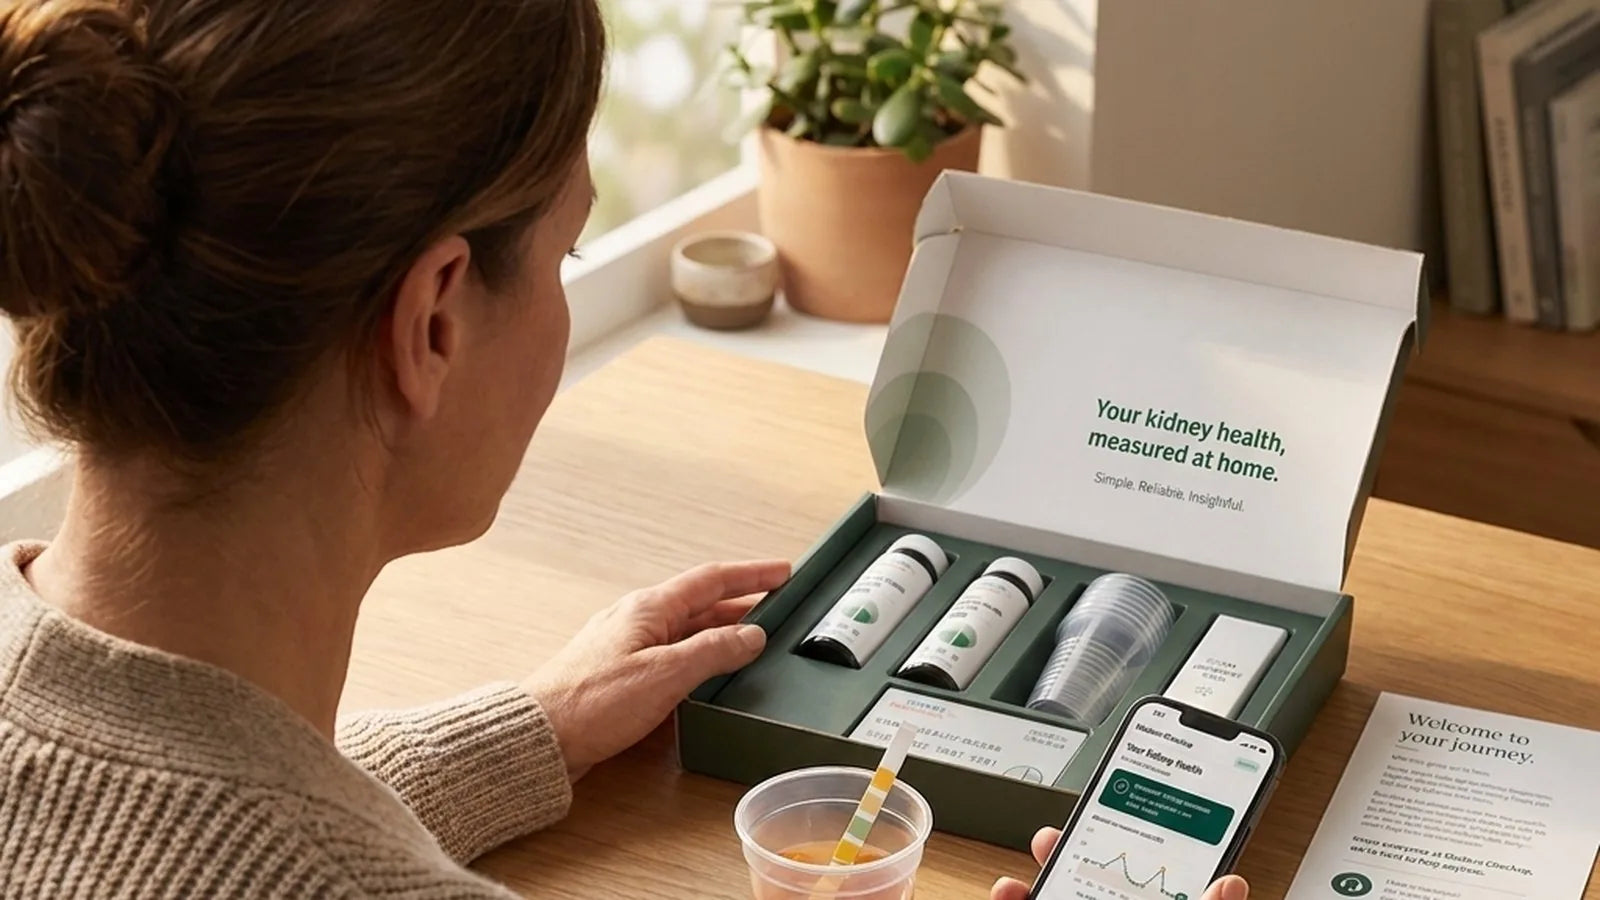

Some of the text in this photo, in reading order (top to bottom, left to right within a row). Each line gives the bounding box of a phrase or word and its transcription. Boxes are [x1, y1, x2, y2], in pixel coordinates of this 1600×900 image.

[1097, 398, 1286, 456] Your kidney health,
[1088, 431, 1279, 482] measured at home.
[1094, 471, 1135, 490] Simple.
[1408, 712, 1530, 746] Welcome to
[1398, 730, 1534, 765] your journey.
